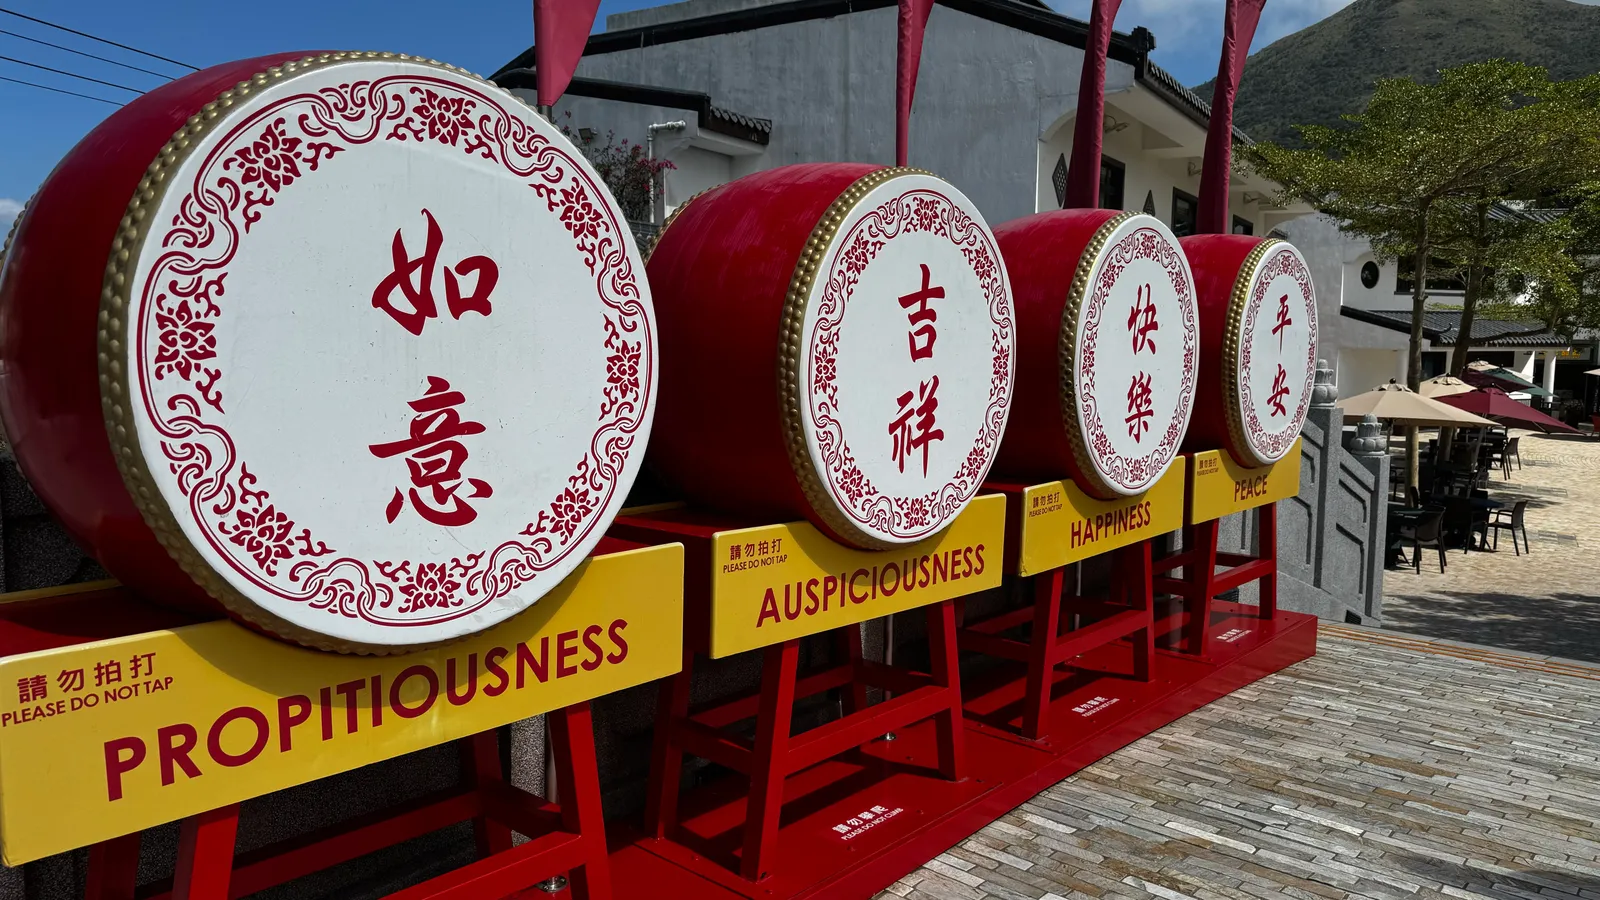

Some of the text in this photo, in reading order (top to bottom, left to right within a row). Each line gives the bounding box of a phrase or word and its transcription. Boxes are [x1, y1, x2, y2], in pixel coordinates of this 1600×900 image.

[368, 208, 499, 527] 如意
[888, 263, 945, 478] 吉祥
[1125, 283, 1159, 444] 快樂
[1267, 294, 1292, 417] 平安
[1234, 474, 1268, 502] PEACE
[730, 538, 782, 560] 請勿拍打
[1070, 501, 1151, 549] HAPPINESS
[723, 554, 788, 573] PLEASE DO NOT TAP
[756, 544, 985, 628] AUSPICIOUSNESS
[1, 676, 174, 727] PLEASE DO NOT TAP
[17, 652, 156, 704] 請勿拍打
[103, 618, 630, 802] PROPITIOUSNESS
[841, 807, 904, 840] PLEASE DO NOT CLIMB
